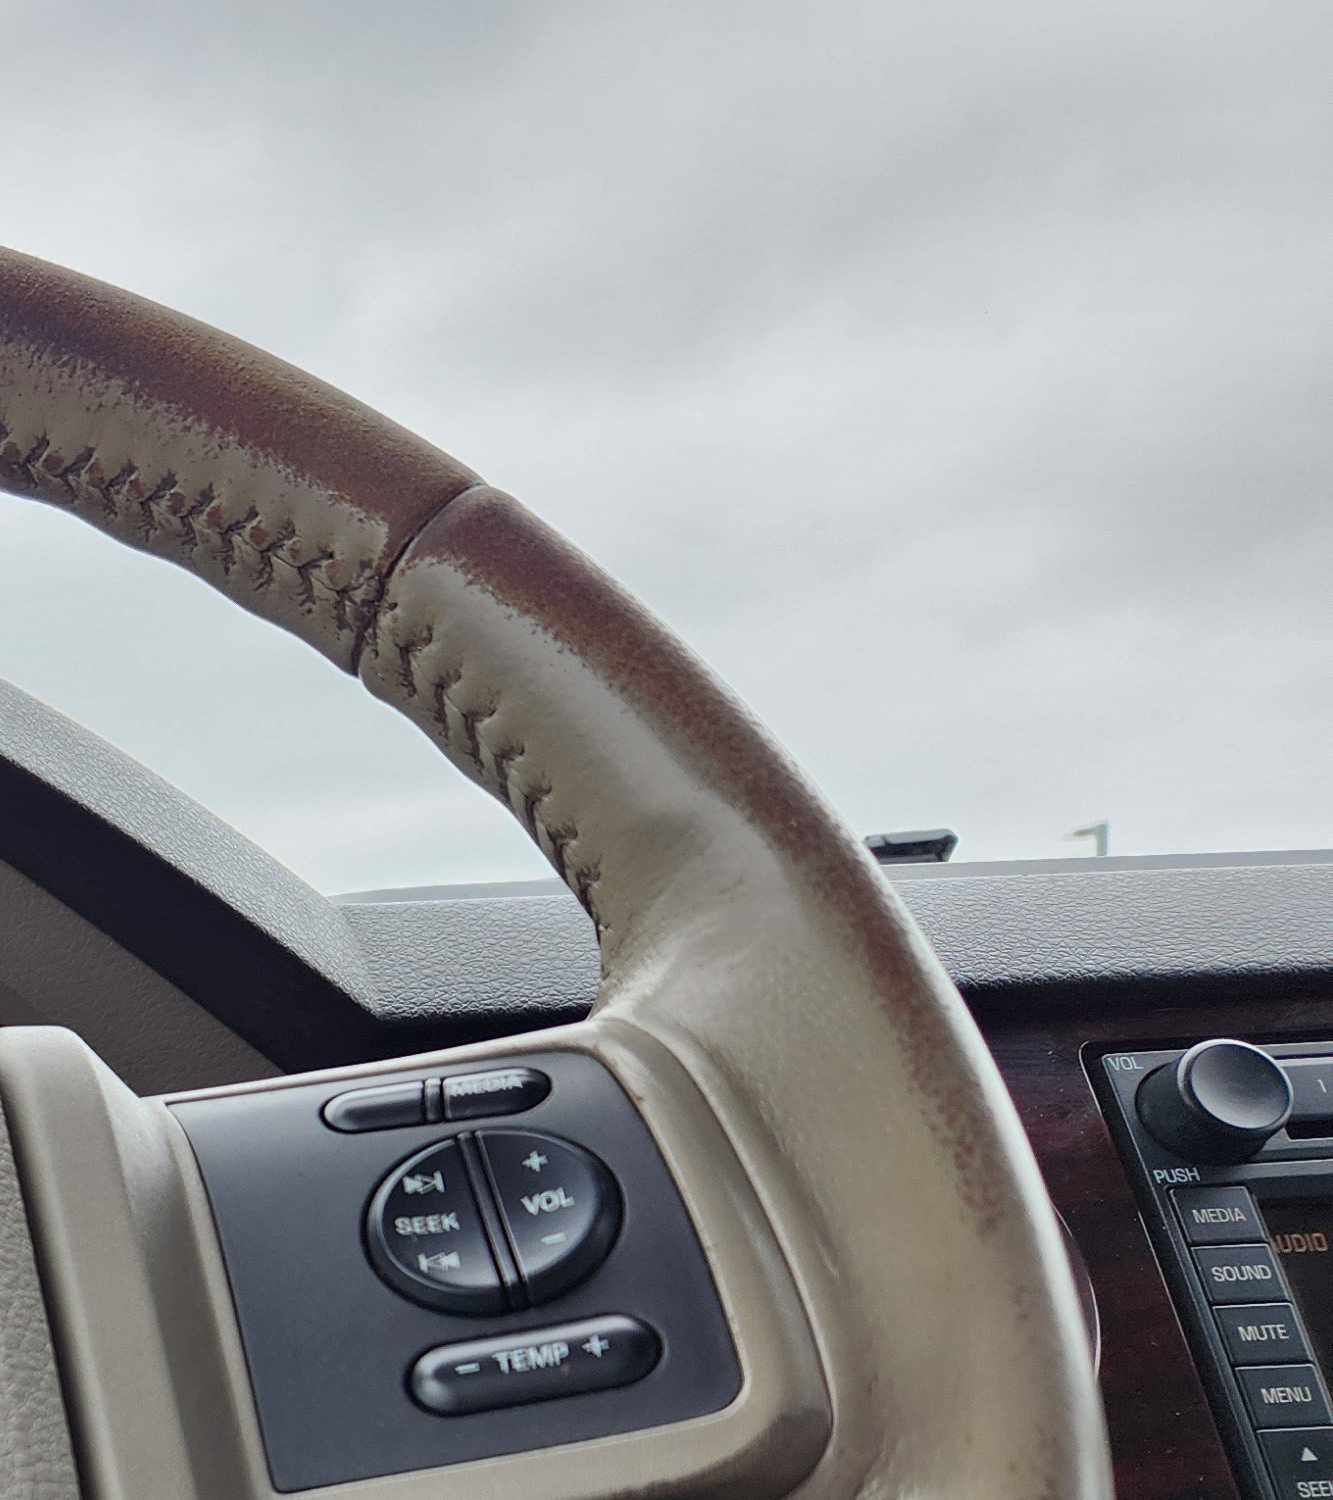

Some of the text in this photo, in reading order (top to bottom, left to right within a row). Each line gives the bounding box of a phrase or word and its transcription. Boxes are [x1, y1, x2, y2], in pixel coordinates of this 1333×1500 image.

[1108, 1056, 1142, 1070] VOL
[1153, 1167, 1199, 1183] PUSH
[521, 1187, 573, 1214] VOL
[1192, 1207, 1245, 1222] MEDIA
[394, 1212, 458, 1235] SEEK
[1272, 1232, 1326, 1252] UDIO
[1211, 1264, 1270, 1281] SOUND
[1237, 1324, 1287, 1340] MUTE
[493, 1341, 568, 1373] TEMP
[1260, 1387, 1310, 1403] MENU
